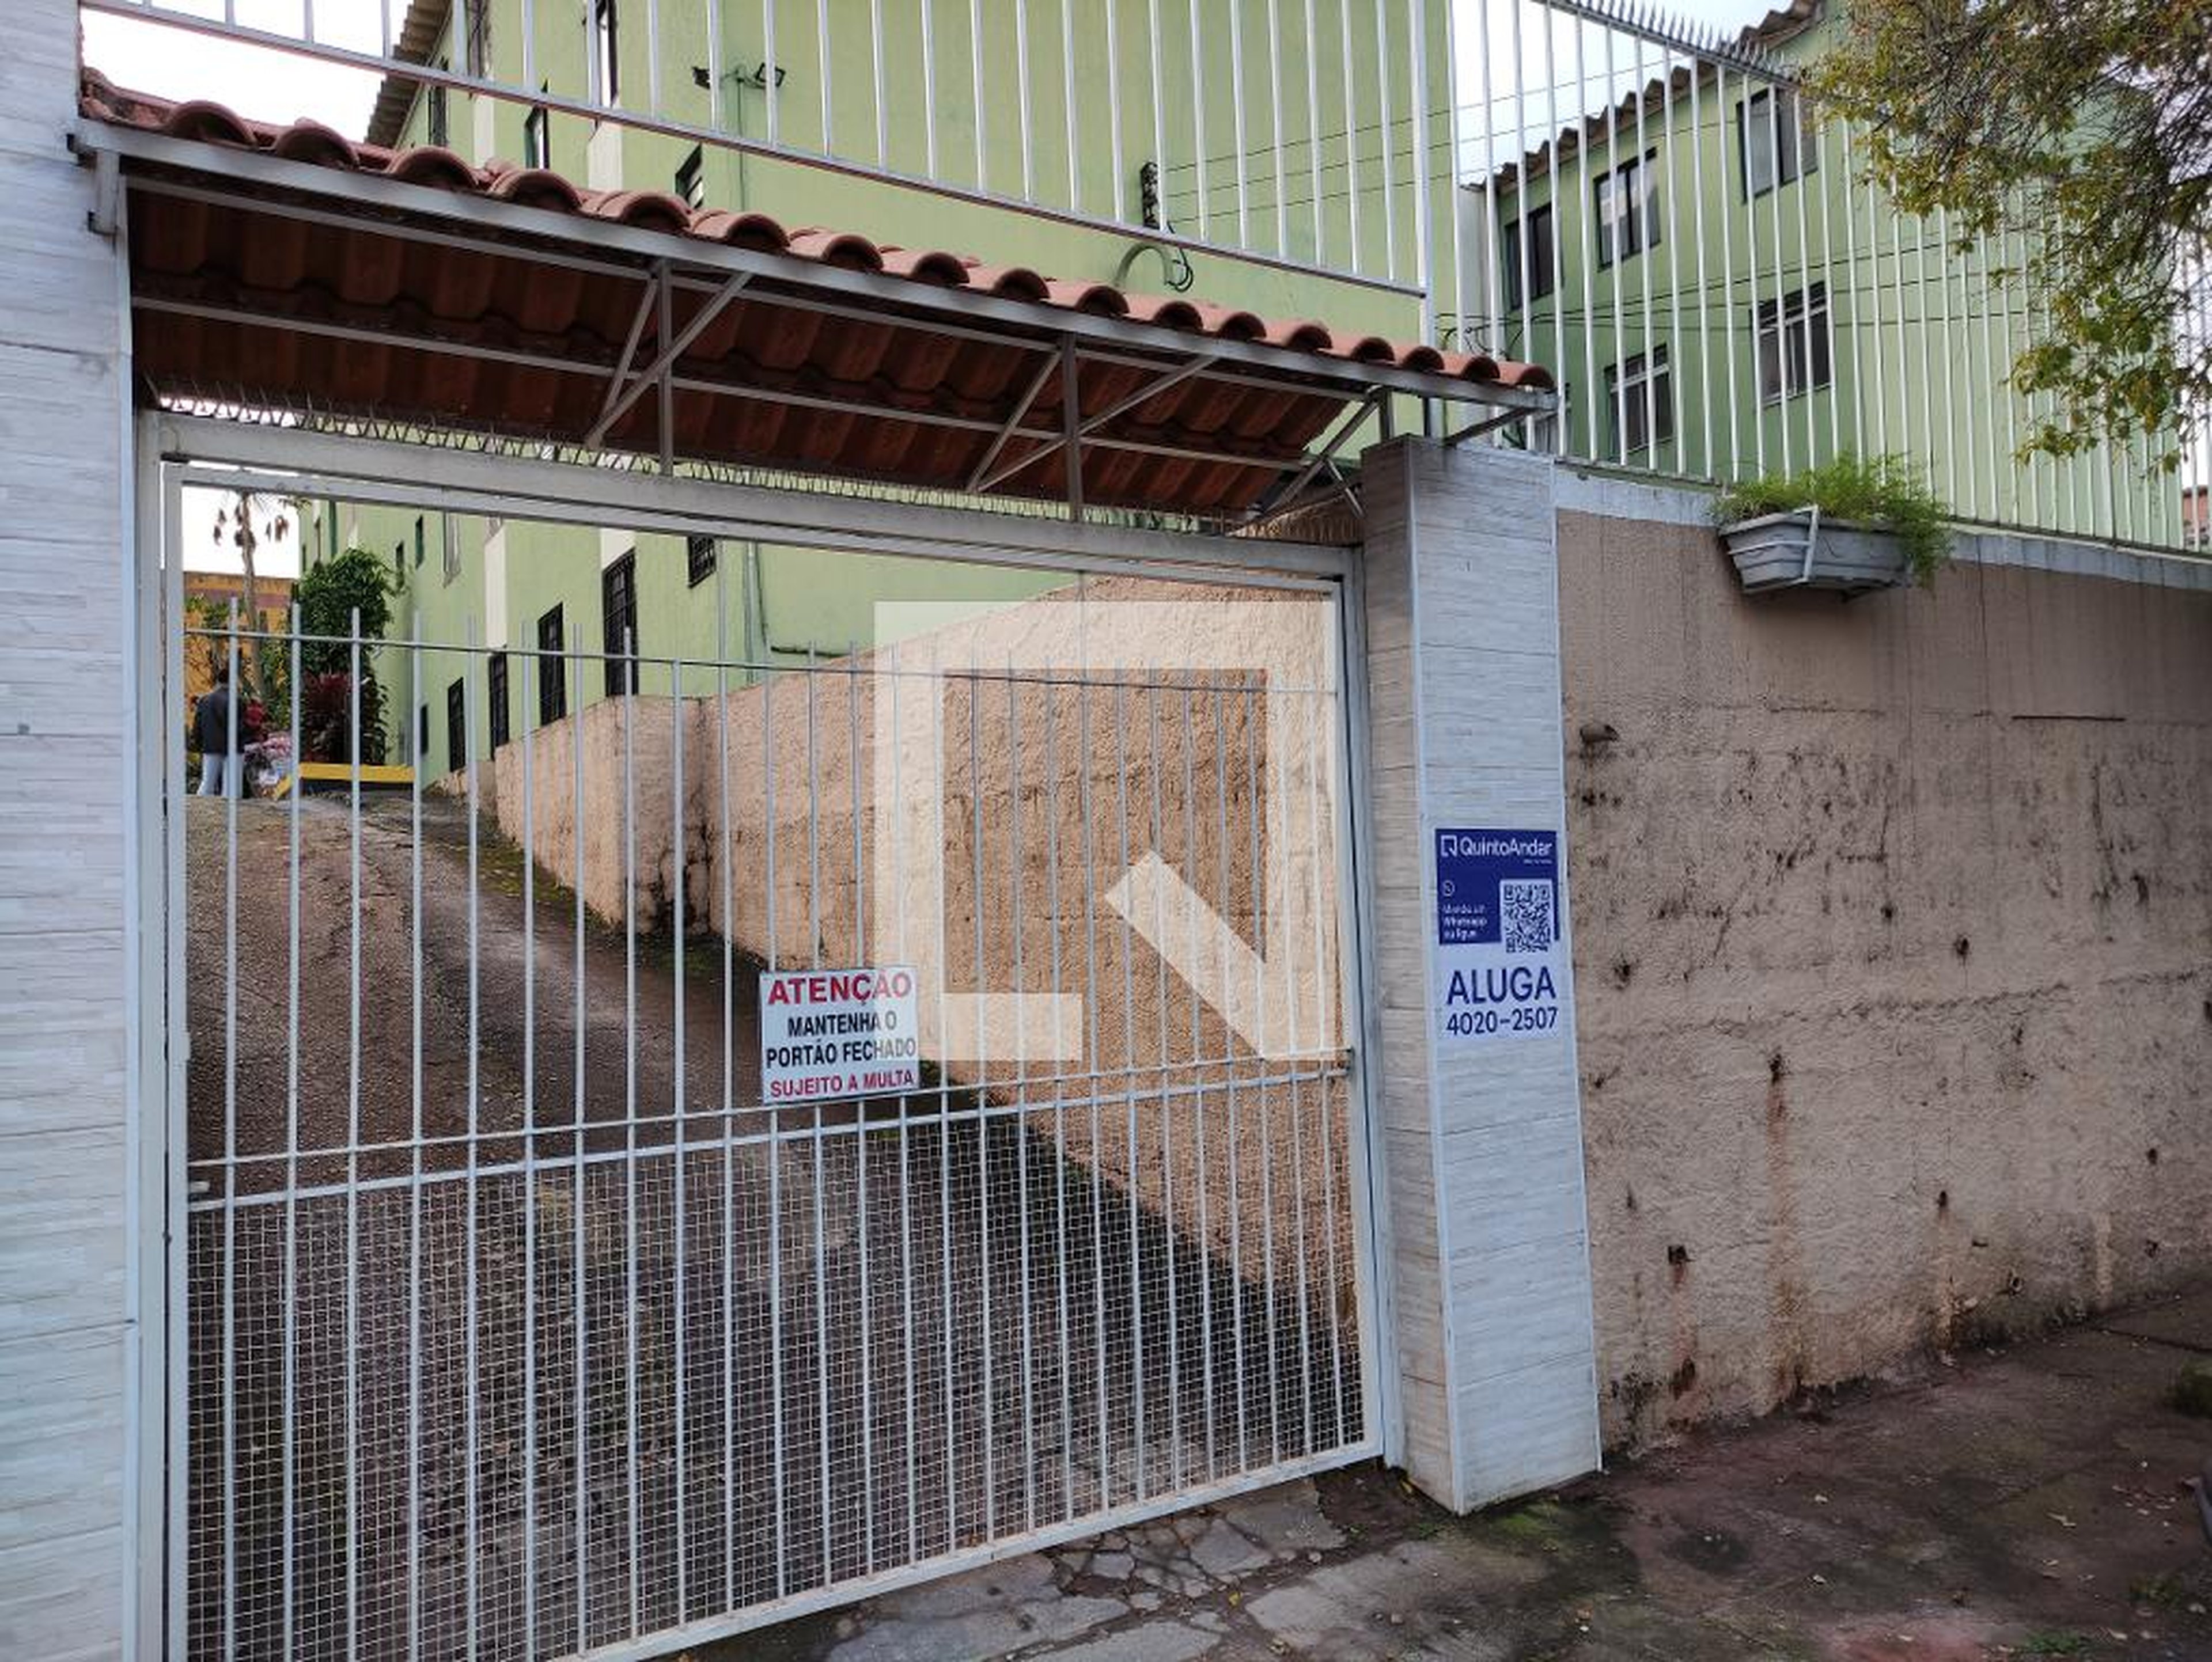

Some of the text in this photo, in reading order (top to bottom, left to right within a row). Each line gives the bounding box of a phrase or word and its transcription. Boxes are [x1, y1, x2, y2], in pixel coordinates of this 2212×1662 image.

[1459, 836, 1553, 857] QuintoAndar
[768, 969, 911, 1005] ATENÇÃO
[1446, 966, 1556, 1005] ALUGA
[787, 1010, 897, 1037] MANTENHA O
[1446, 1007, 1559, 1035] 4020-2507
[766, 1038, 916, 1068] PORTÃO FECHADO
[770, 1069, 914, 1098] SUJEITO A MULTA
